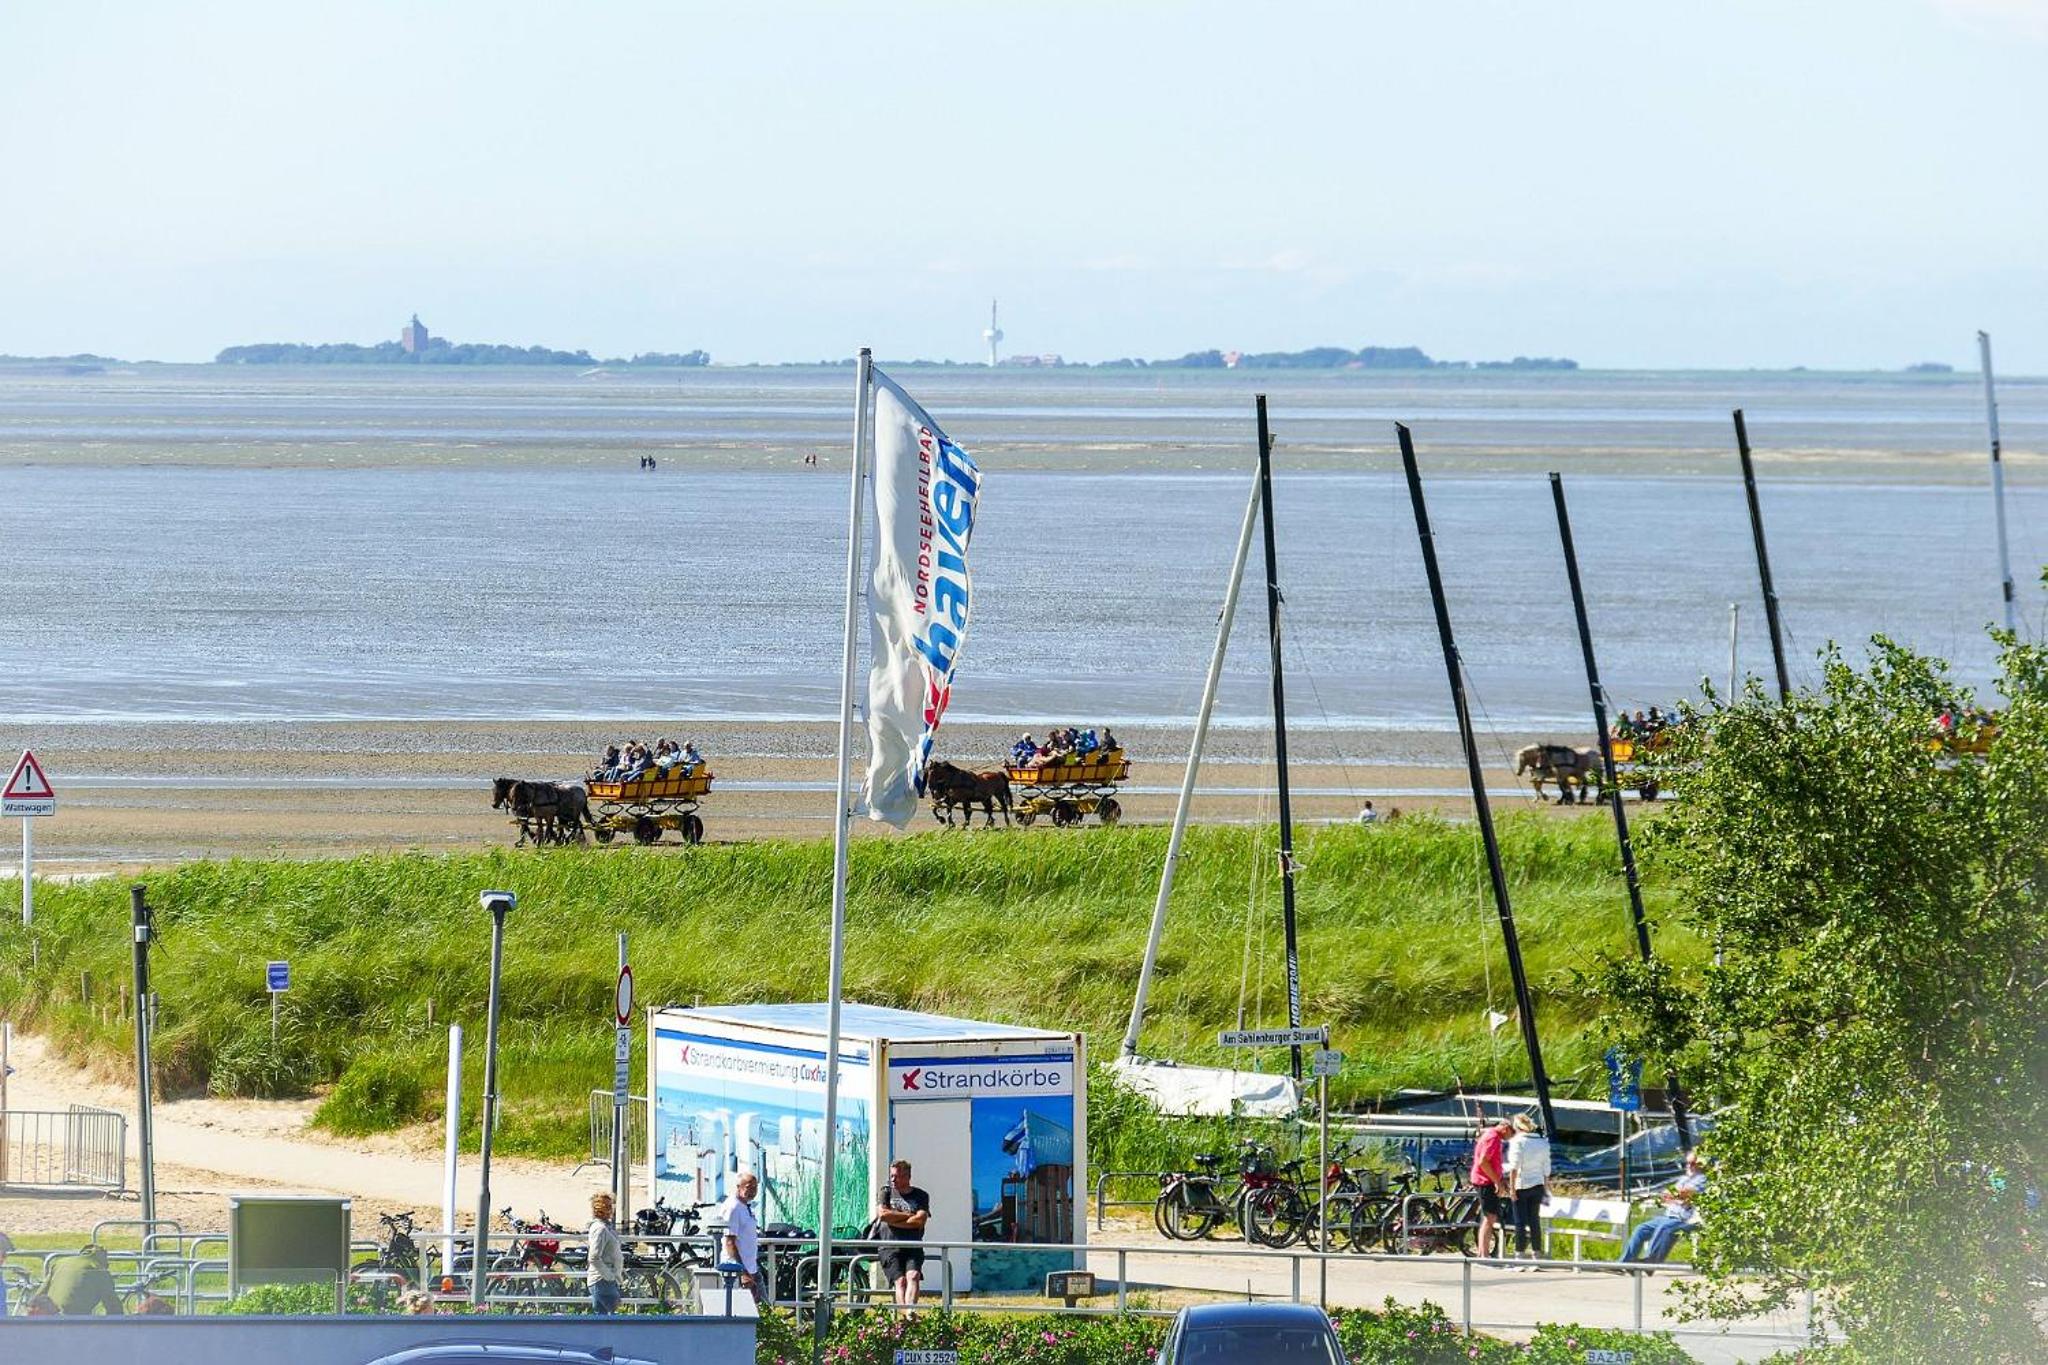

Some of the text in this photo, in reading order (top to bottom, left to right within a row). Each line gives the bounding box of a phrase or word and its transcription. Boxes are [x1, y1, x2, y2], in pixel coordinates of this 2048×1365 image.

[913, 426, 932, 615] NORDSEEHEILBAD
[4, 803, 52, 813] Wattwagen
[1223, 1029, 1321, 1045] Am Sahlenburger Strand
[690, 1048, 798, 1084] Strandkorbvermietung
[923, 1068, 1062, 1089] Strandkörbe
[904, 1352, 922, 1363] CUX
[925, 1352, 931, 1363] S
